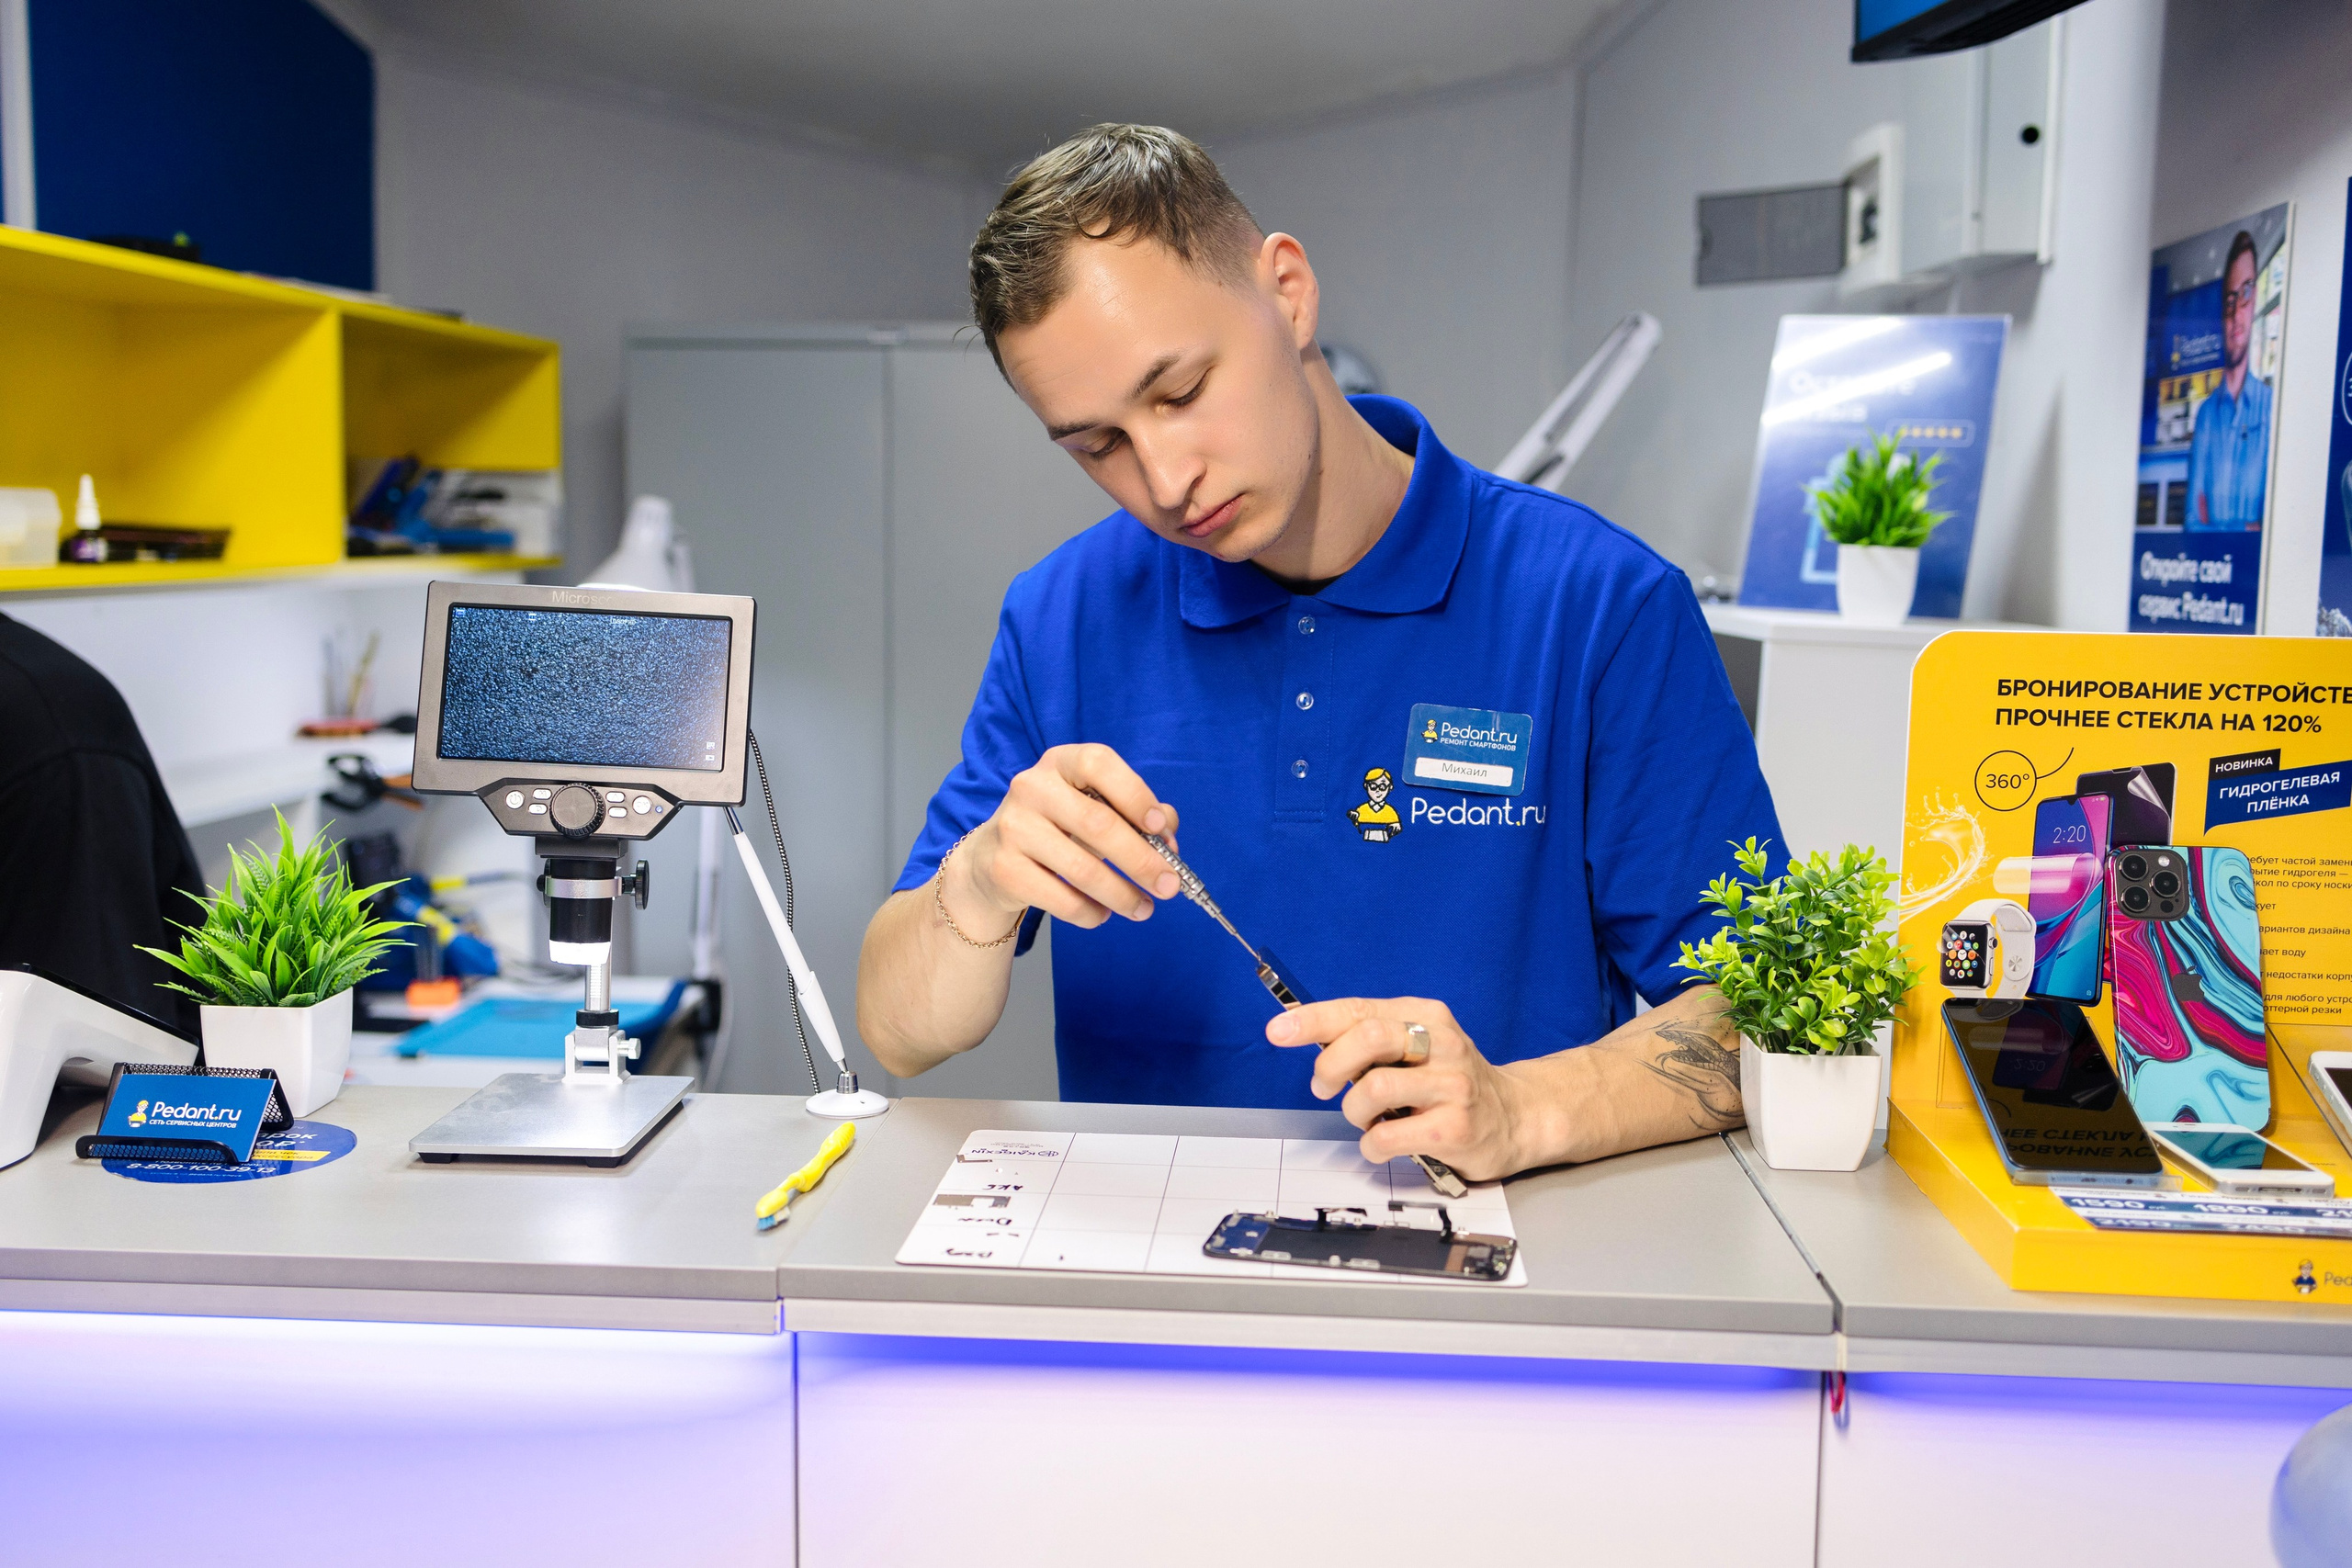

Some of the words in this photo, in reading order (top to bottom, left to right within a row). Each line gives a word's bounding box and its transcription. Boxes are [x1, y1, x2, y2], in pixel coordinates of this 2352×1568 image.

[2199, 554, 2233, 584] свой
[552, 591, 612, 605] Microsc
[2182, 592, 2245, 626] Pedant.ru
[1997, 679, 2202, 701] БРОНИРОВАНИЕ
[1996, 708, 2109, 728] ПРОЧНЕЕ
[2117, 711, 2213, 730] СТЕКЛА
[2221, 714, 2256, 731] НА
[2262, 714, 2322, 733] 120%
[1440, 722, 1518, 744] Pedant.ru
[1440, 738, 1467, 747] РЕМОНТ
[1469, 740, 1516, 751] СМАРТФОНОВ
[1442, 762, 1487, 778] Михаил
[2215, 757, 2273, 773] НОВИНКА
[1985, 773, 2030, 789] 360°
[2219, 771, 2341, 799] ГИДРОГЕЛЕВАЯ
[1411, 797, 1546, 826] Pedant.ru
[2247, 794, 2310, 814] ПЛЁНКА
[2052, 825, 2086, 844] 2:20
[2281, 857, 2315, 865] частой
[2282, 870, 2335, 878] гидрогеля
[2291, 882, 2322, 890] сроку
[2308, 926, 2350, 935] дизайна
[2281, 949, 2306, 958] воду
[2267, 971, 2324, 979] недостатки
[2264, 994, 2283, 1002] для
[2285, 994, 2324, 1002] любого
[151, 1101, 242, 1122] Pedant.ru
[206, 1121, 237, 1129] ЦЕНТРОВ
[2070, 1198, 2145, 1209] 1590
[2193, 1203, 2269, 1214] 1890
